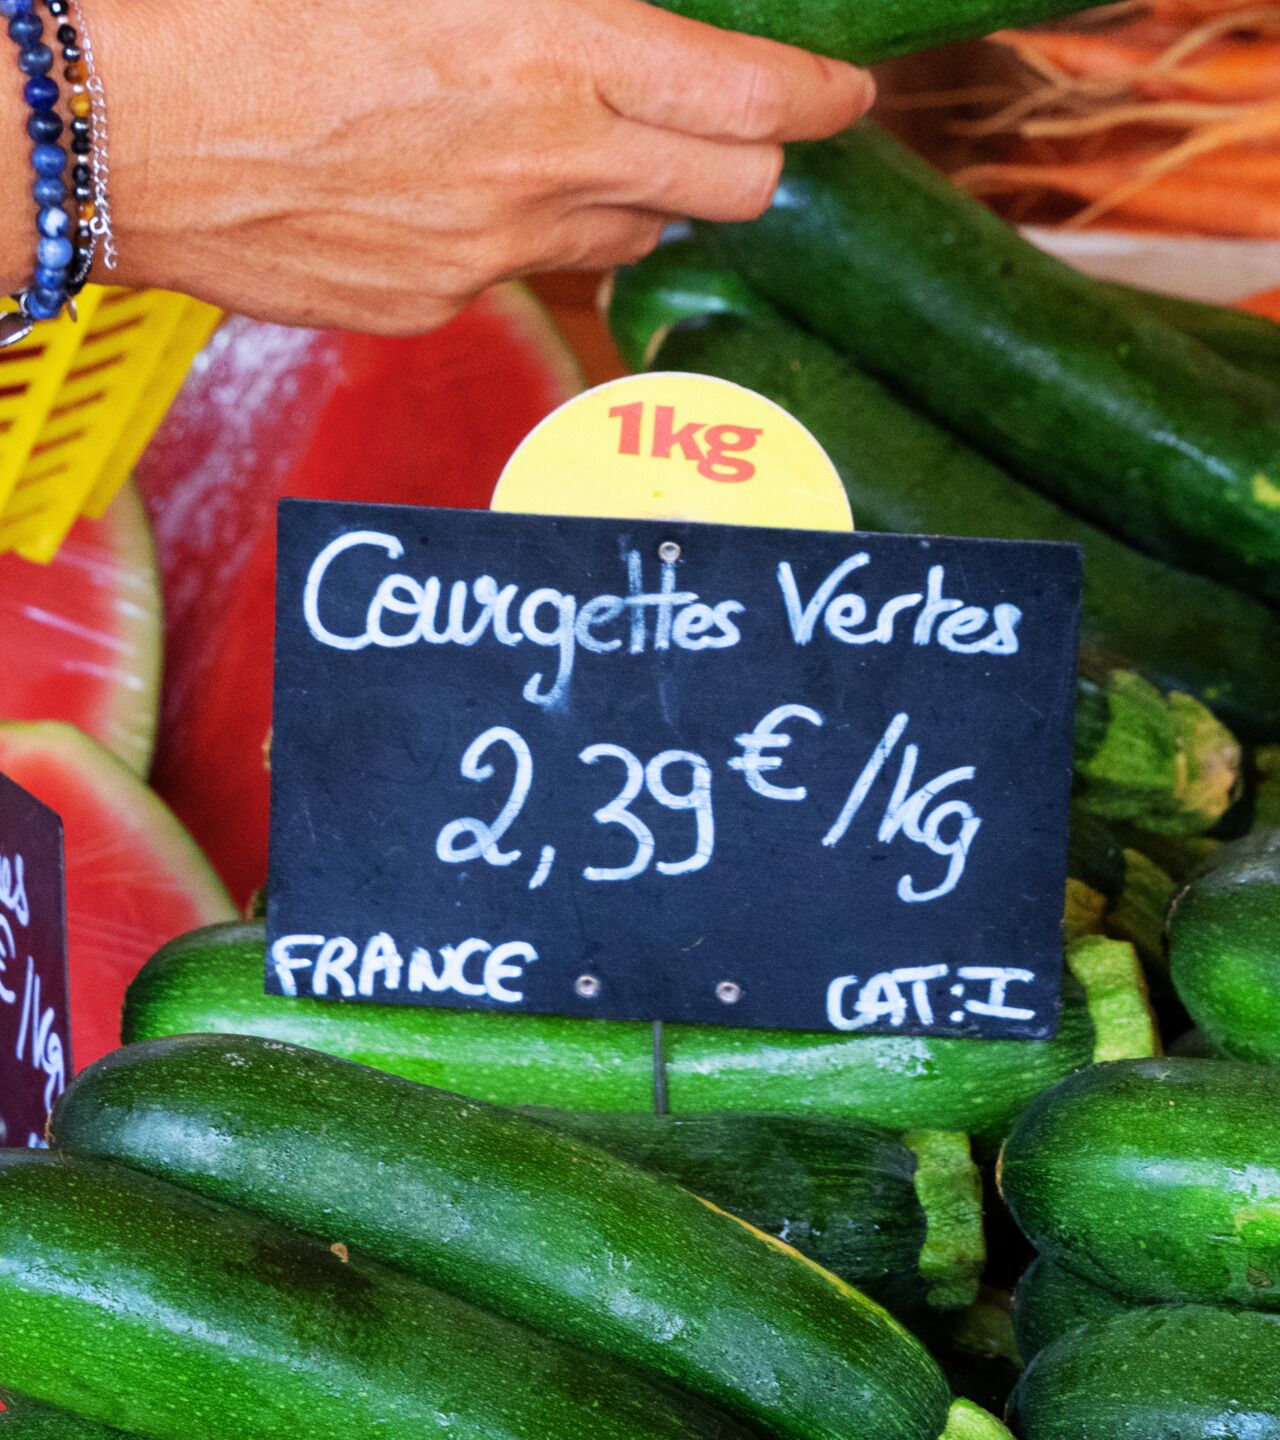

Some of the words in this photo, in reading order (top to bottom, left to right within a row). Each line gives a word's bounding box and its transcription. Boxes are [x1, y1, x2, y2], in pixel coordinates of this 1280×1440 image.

[609, 401, 763, 483] 1kg
[303, 531, 745, 708] Courgettes
[777, 552, 1022, 655] Vertes
[272, 932, 538, 1002] FRANCE
